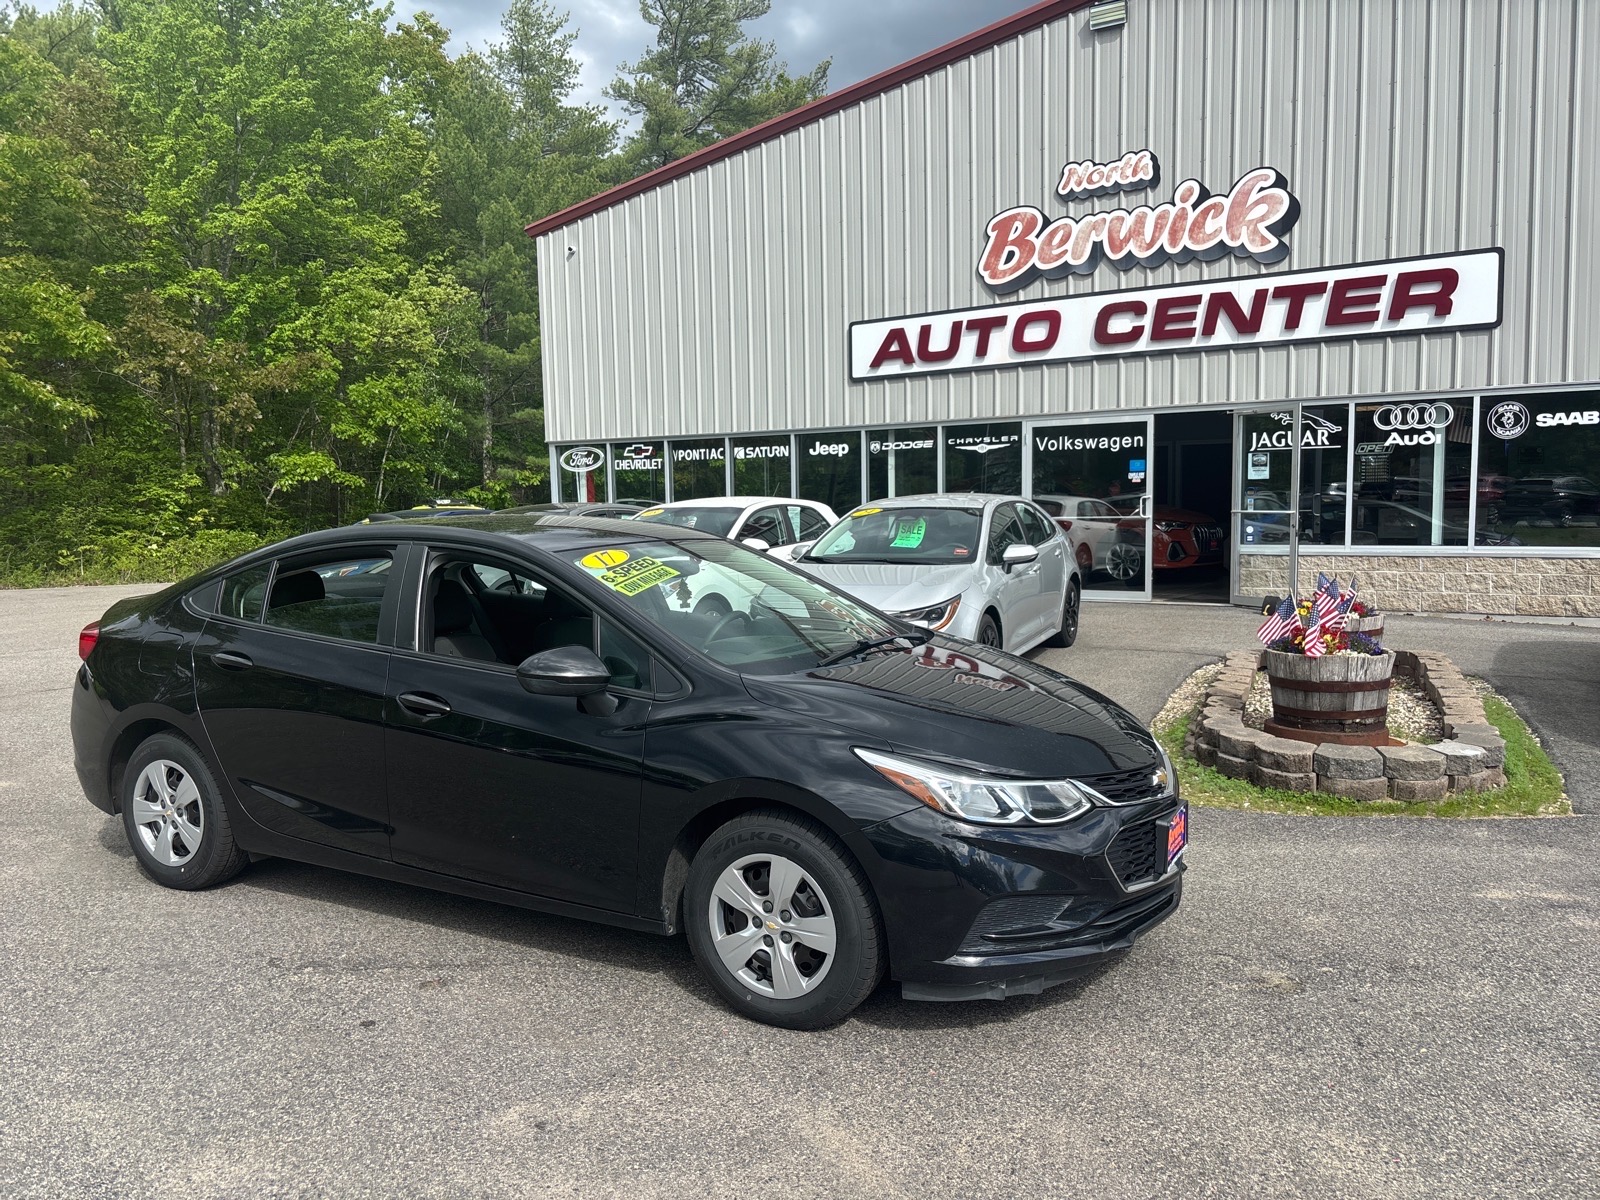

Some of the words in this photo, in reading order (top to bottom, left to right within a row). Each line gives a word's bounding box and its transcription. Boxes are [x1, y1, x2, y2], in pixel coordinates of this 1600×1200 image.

[1059, 151, 1153, 193] North
[980, 170, 1288, 283] Berwick
[869, 309, 1062, 368] AUTO
[1093, 267, 1459, 344] CENTER
[1498, 404, 1520, 413] SAAB
[1536, 411, 1600, 427] SAAB
[882, 440, 934, 450] DODGE
[948, 435, 1018, 445] CHRYSLER
[1036, 435, 1144, 452] Volkswagen
[1384, 430, 1442, 446] Audi
[678, 447, 724, 461] PONTIAC
[745, 445, 789, 458] SATURN
[809, 441, 849, 457] Jeep
[1358, 444, 1392, 453] OPEN
[570, 451, 594, 466] Ford
[614, 458, 662, 470] CHEVROLET
[900, 525, 923, 535] SALE
[593, 550, 616, 567] 17
[600, 558, 656, 583] 6-SPEED
[712, 830, 802, 859] FALKEN
